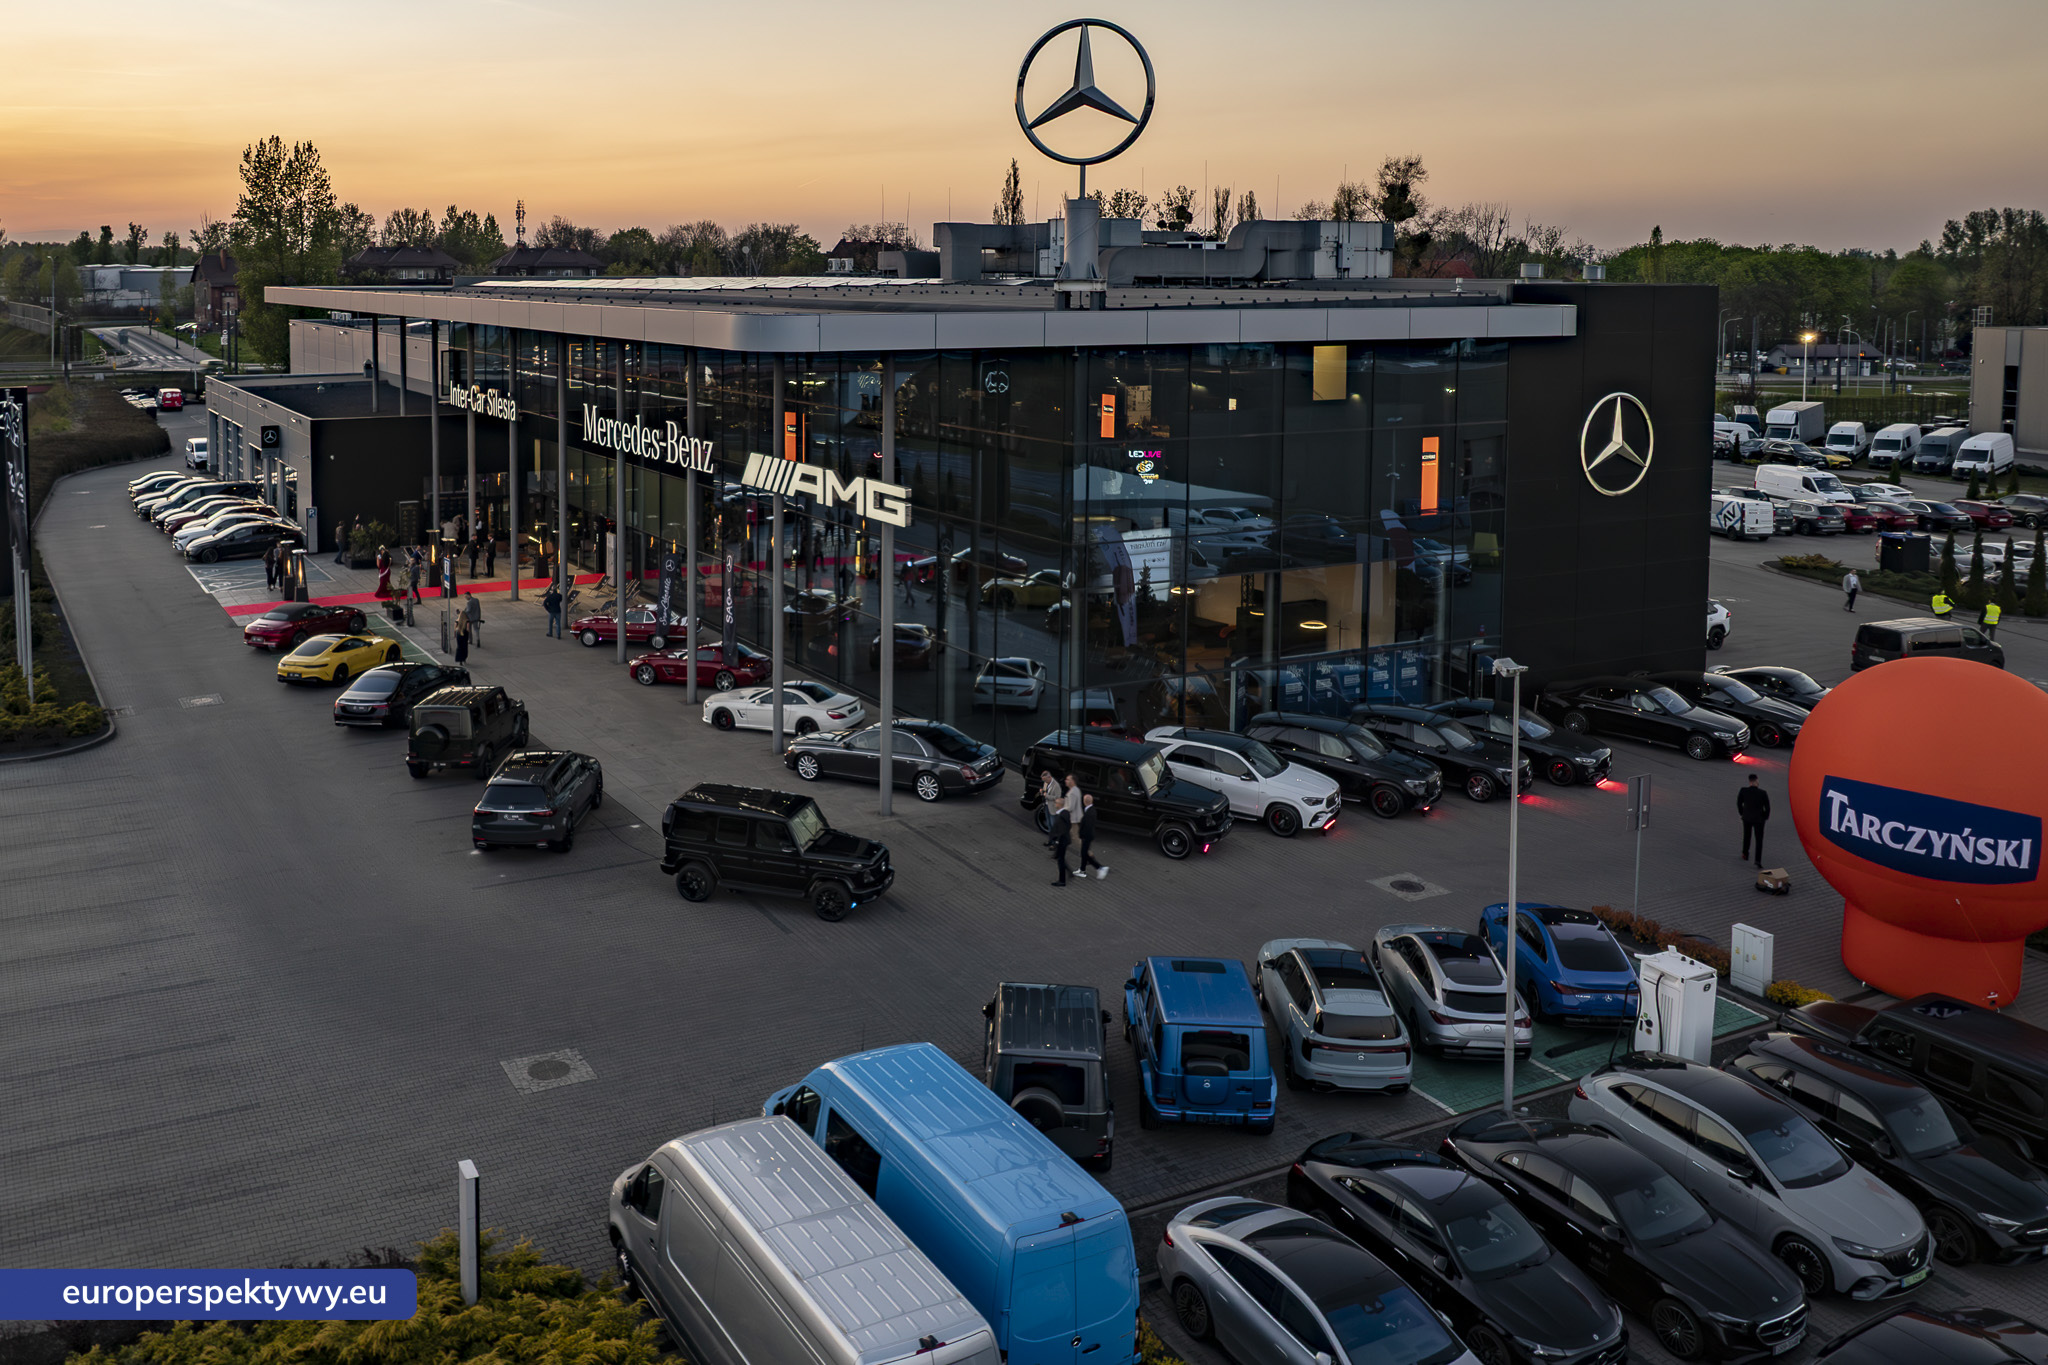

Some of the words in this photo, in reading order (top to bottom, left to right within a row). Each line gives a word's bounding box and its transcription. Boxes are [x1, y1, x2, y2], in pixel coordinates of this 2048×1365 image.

[450, 380, 485, 413] Inter-Car
[487, 388, 516, 421] Silesia
[583, 403, 713, 473] Mercedes-Benz
[1826, 789, 2032, 869] TARCZYŃSKI
